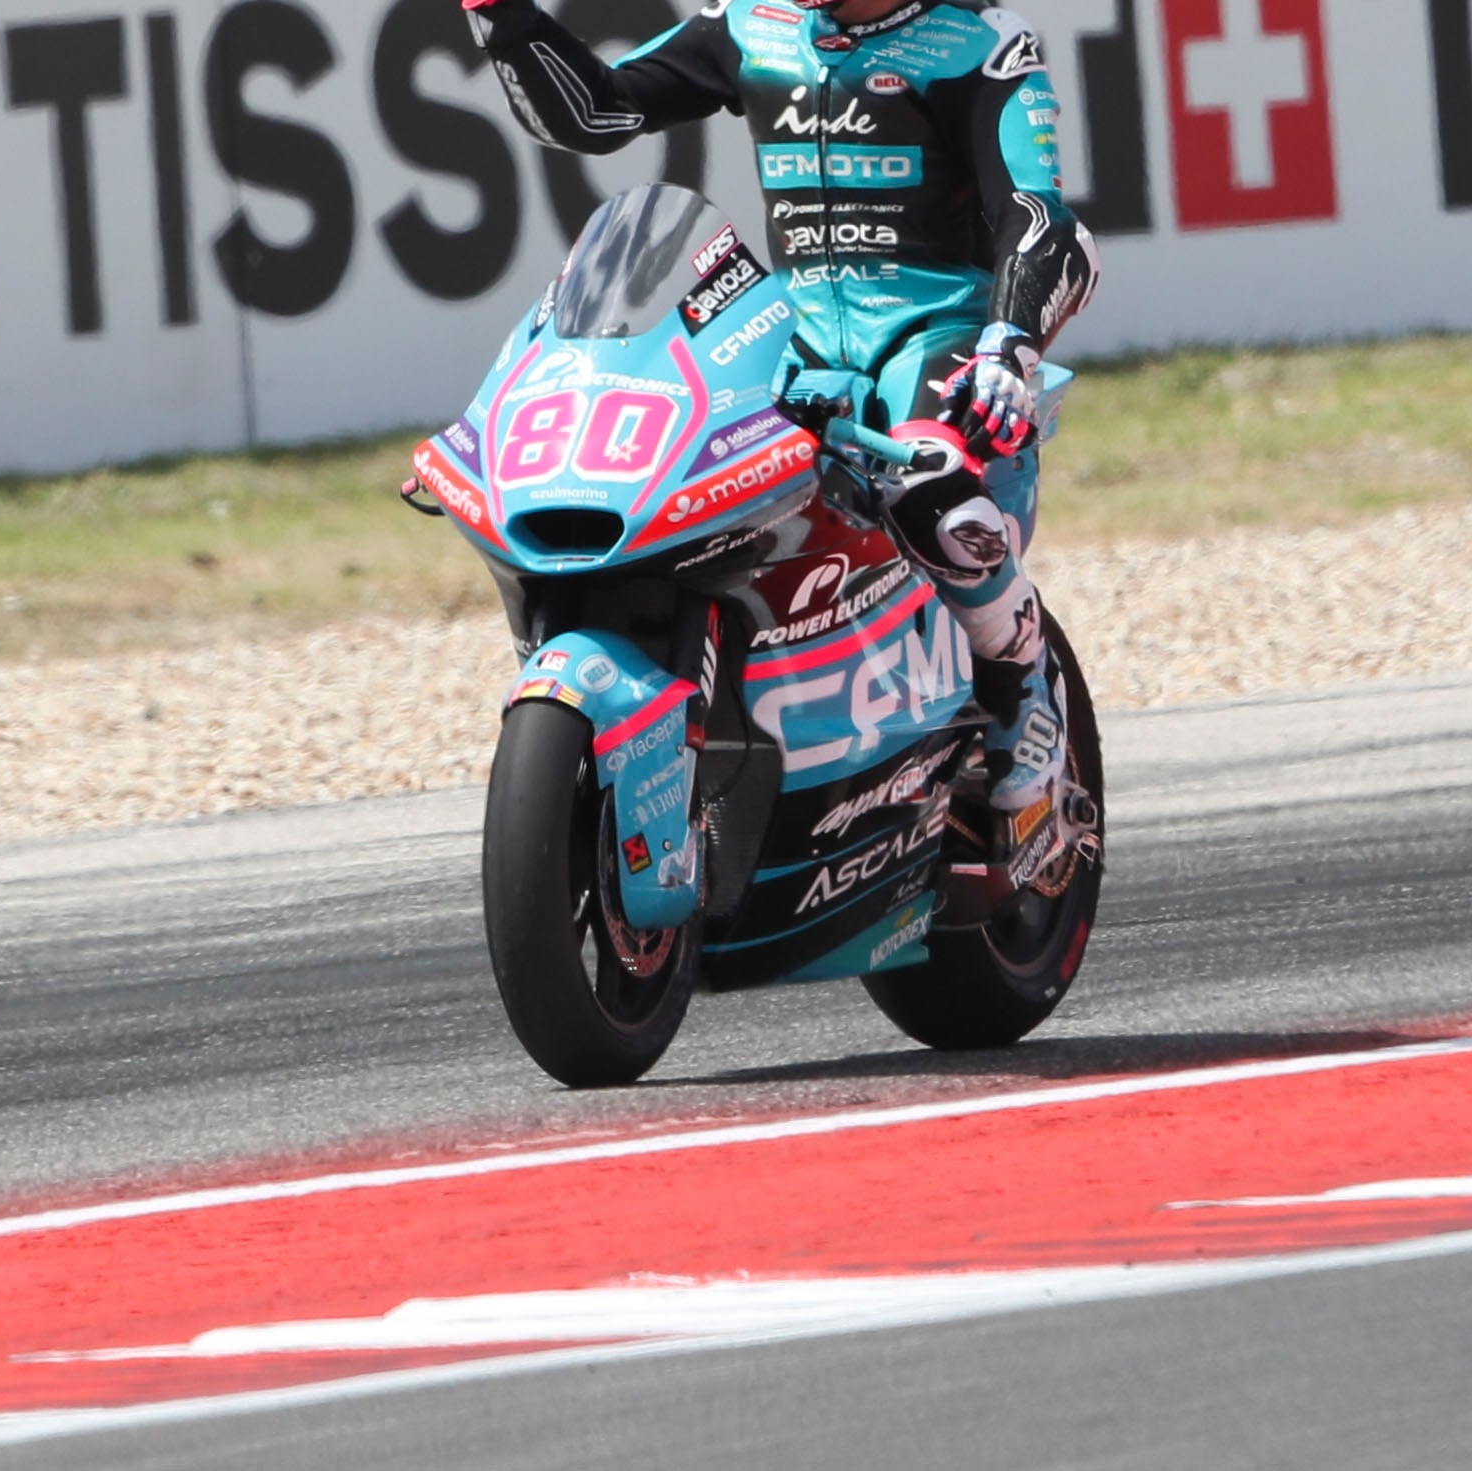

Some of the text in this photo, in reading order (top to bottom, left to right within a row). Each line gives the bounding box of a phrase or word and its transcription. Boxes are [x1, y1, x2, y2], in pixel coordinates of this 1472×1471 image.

[847, 1, 922, 36] alpinestars
[873, 77, 907, 88] BELL
[773, 84, 878, 135] inde
[763, 153, 912, 178] CFMOTO
[693, 227, 737, 275] WRS
[783, 223, 899, 255] gaviota
[685, 252, 756, 324] gaviota
[786, 263, 900, 291] ASCALE
[709, 300, 791, 366] CFMOTO
[561, 372, 692, 397] ELECTRONICS
[495, 390, 681, 490] 80
[726, 415, 782, 444] solunion
[429, 465, 482, 525] mapfre
[530, 487, 609, 501] azulmarino
[708, 441, 814, 505] mapfre
[674, 545, 727, 572] POWER
[750, 608, 833, 648] POWER
[1013, 710, 1058, 774] 80
[795, 794, 948, 915] ASCALE
[1010, 825, 1051, 890] TRIUMPH
[869, 911, 930, 969] MOTOREX
